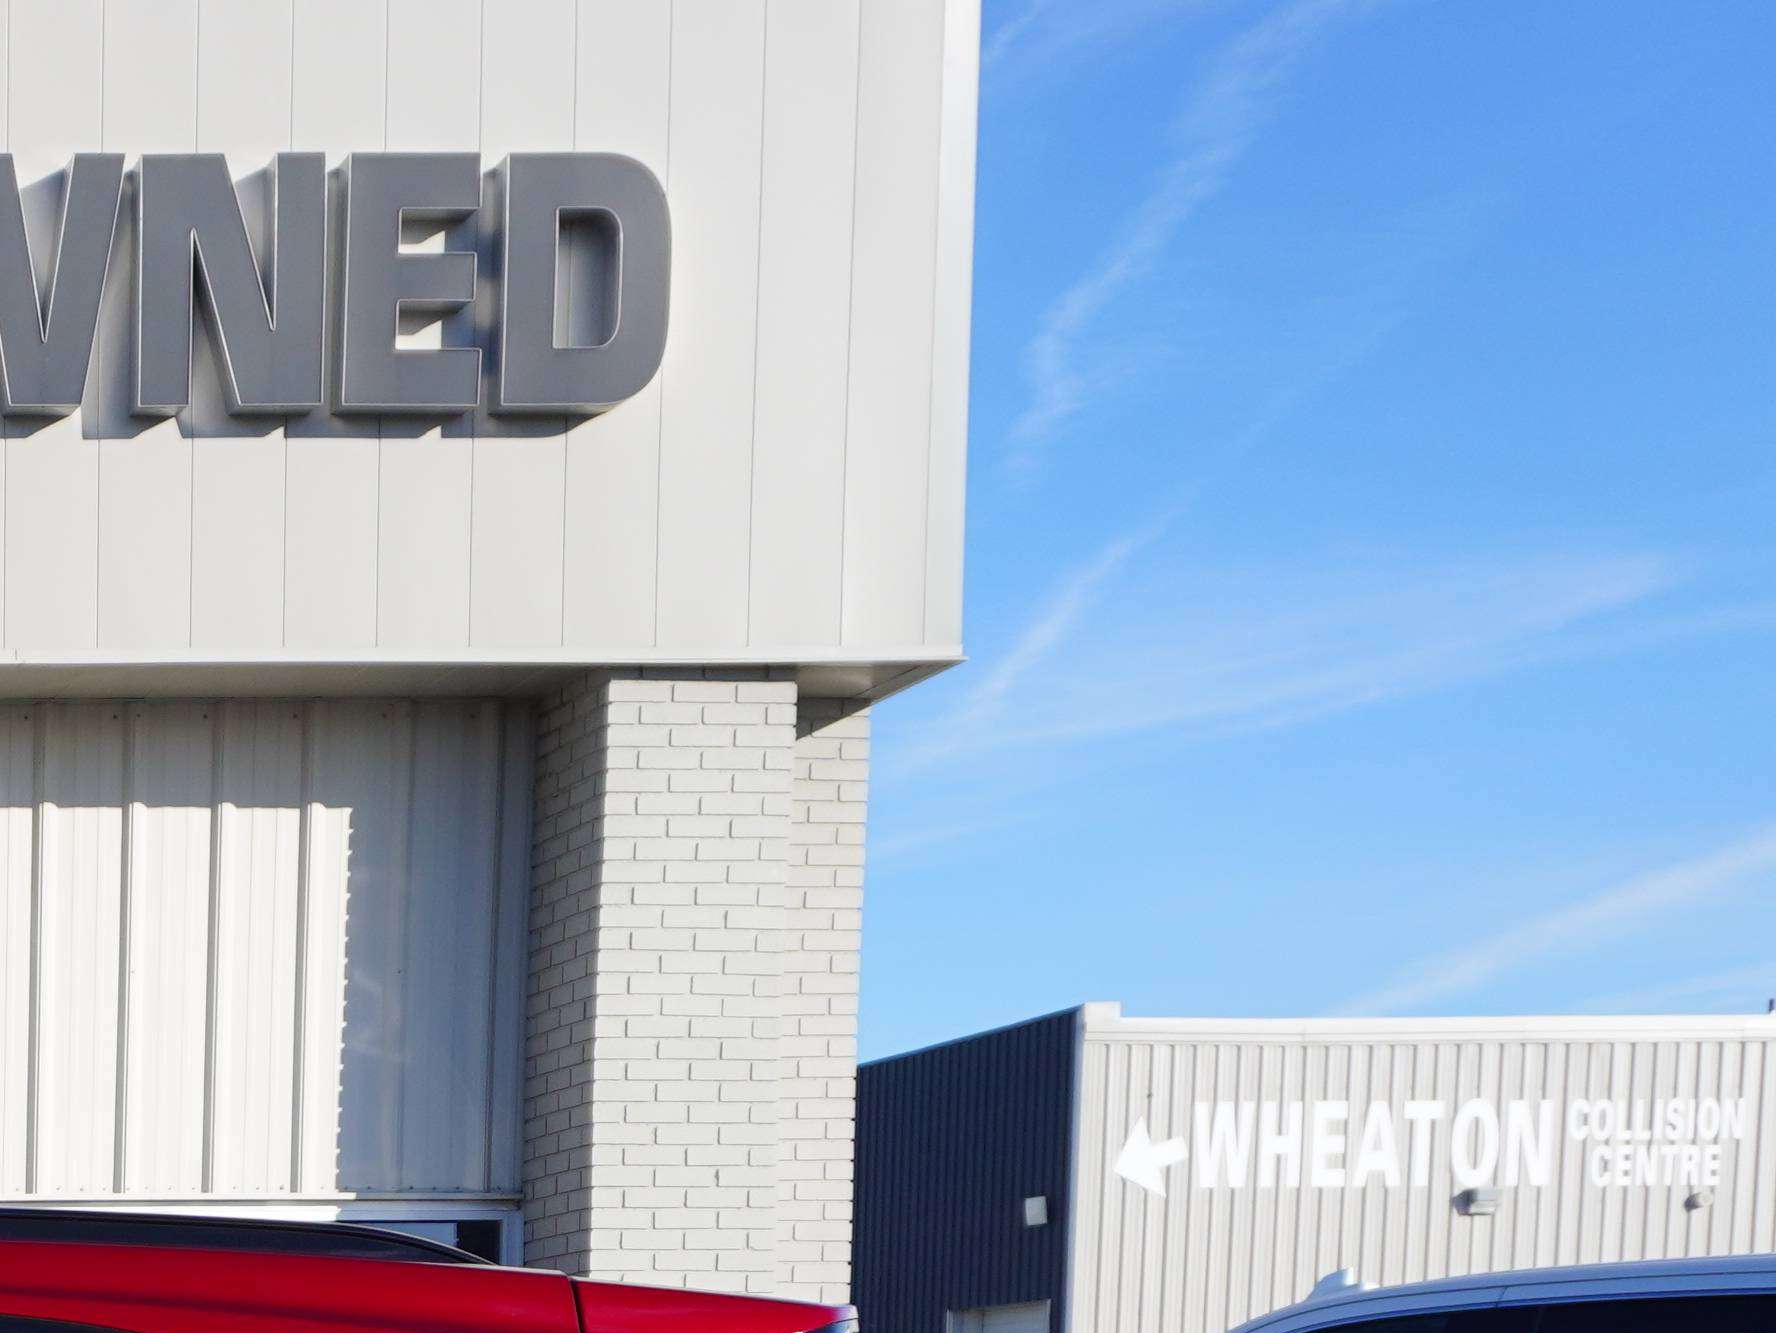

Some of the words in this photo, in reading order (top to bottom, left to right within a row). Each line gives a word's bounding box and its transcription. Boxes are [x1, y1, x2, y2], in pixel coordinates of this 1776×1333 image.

[1194, 1098, 1550, 1189] WHEATON
[1568, 1097, 1746, 1141] COLLISION
[1590, 1144, 1722, 1187] CENTRE
